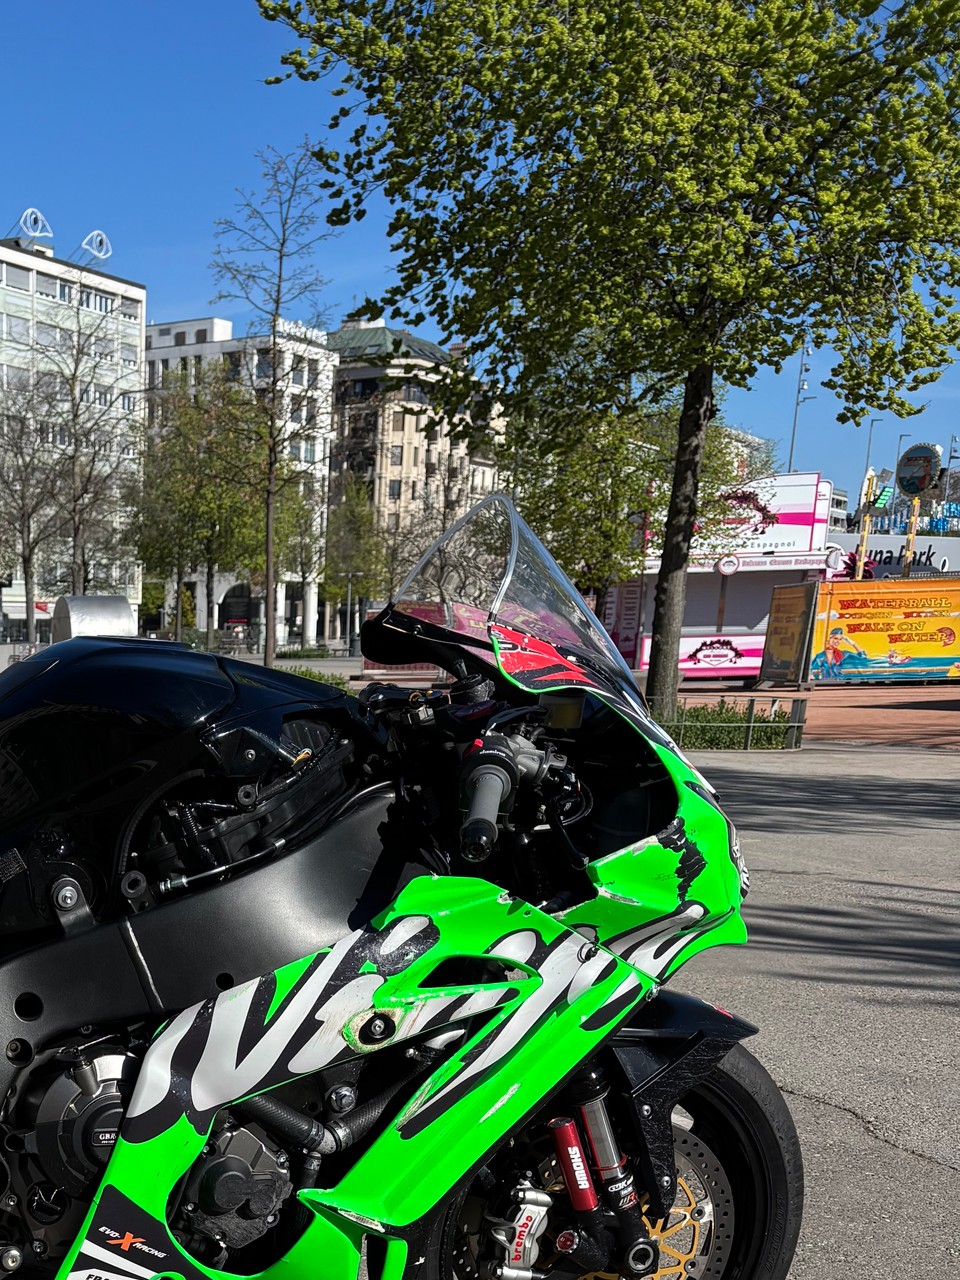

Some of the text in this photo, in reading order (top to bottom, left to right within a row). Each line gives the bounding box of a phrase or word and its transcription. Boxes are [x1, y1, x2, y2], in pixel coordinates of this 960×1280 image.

[750, 541, 796, 551] Espagnol
[897, 621, 927, 632] ON
[567, 1145, 589, 1190] SHOWA
[511, 1214, 533, 1263] brembo
